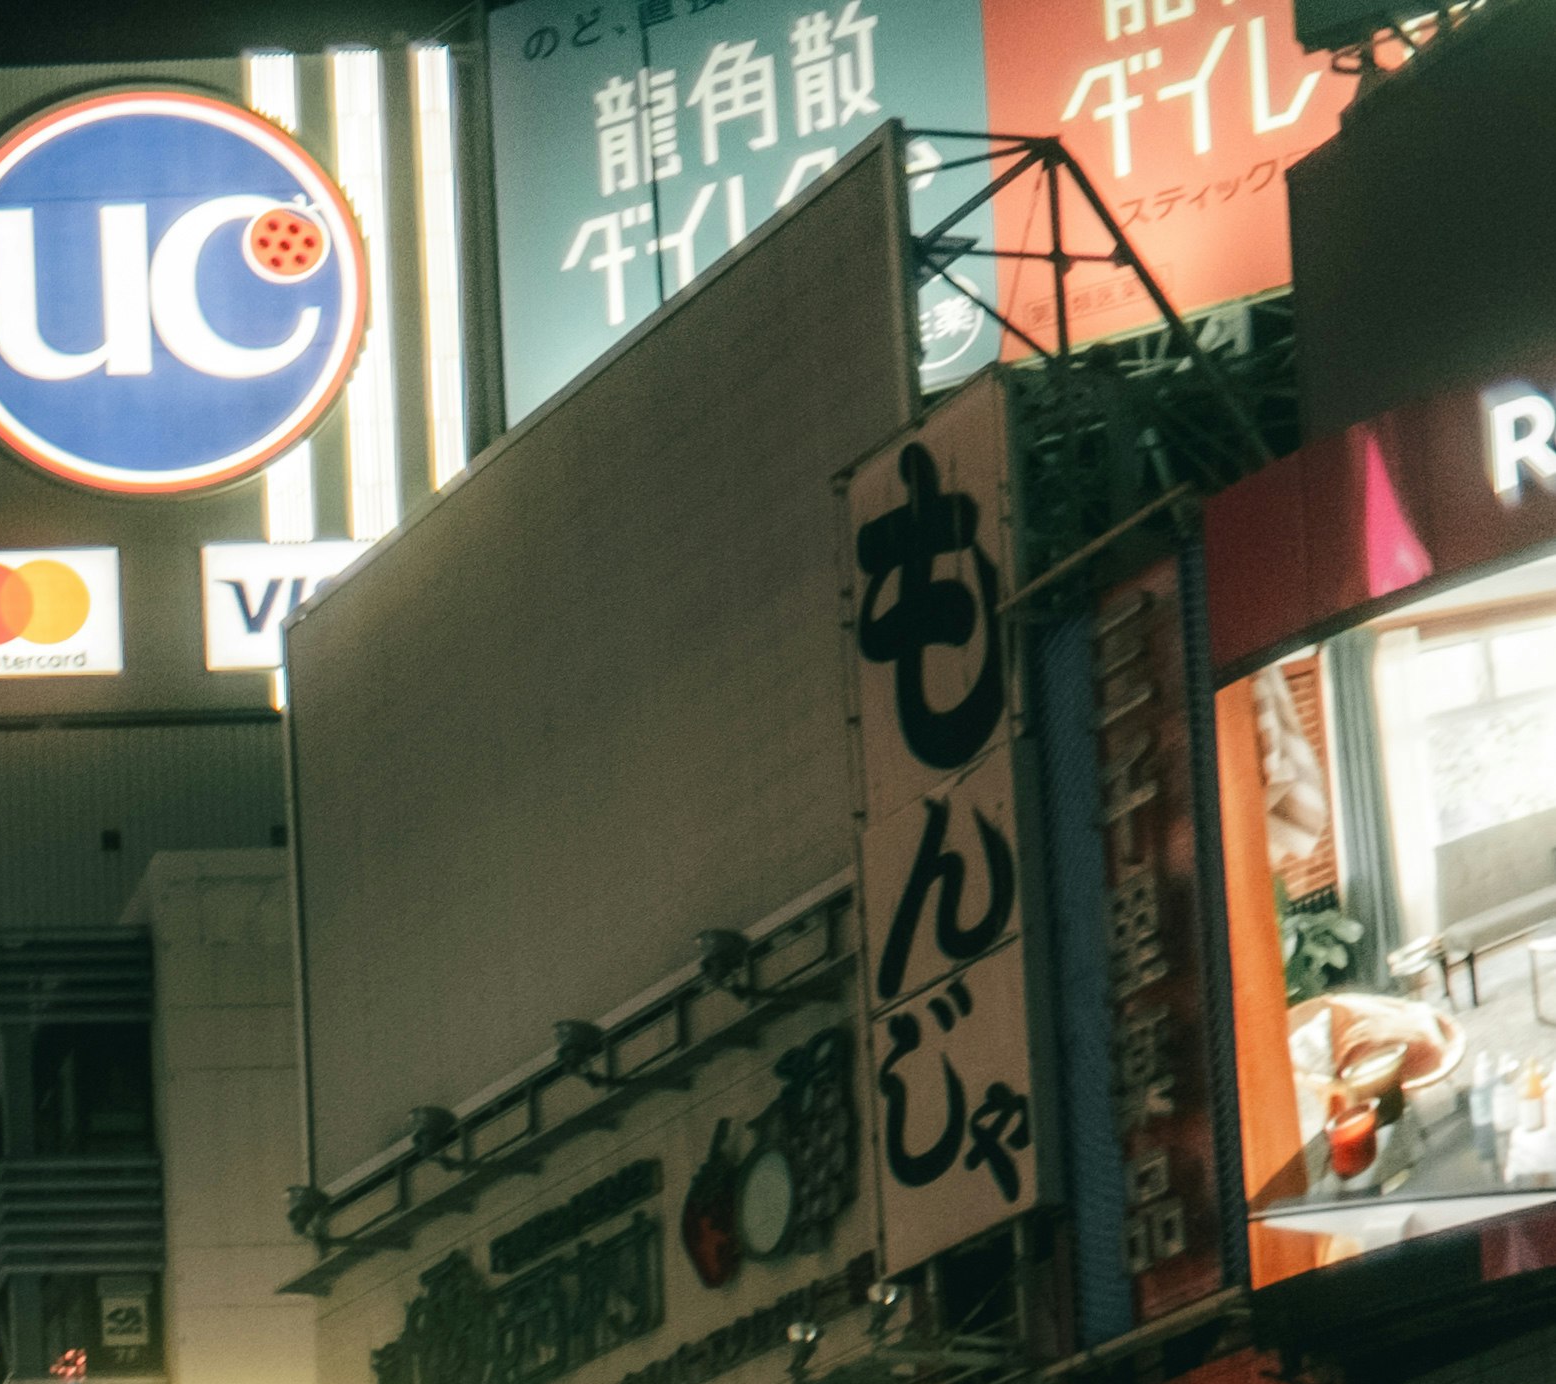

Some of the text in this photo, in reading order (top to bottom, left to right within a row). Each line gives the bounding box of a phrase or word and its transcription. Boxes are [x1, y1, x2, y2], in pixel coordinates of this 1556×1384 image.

[594, 2, 883, 196] 龍角散
[857, 442, 1029, 1202] もんじゃ
